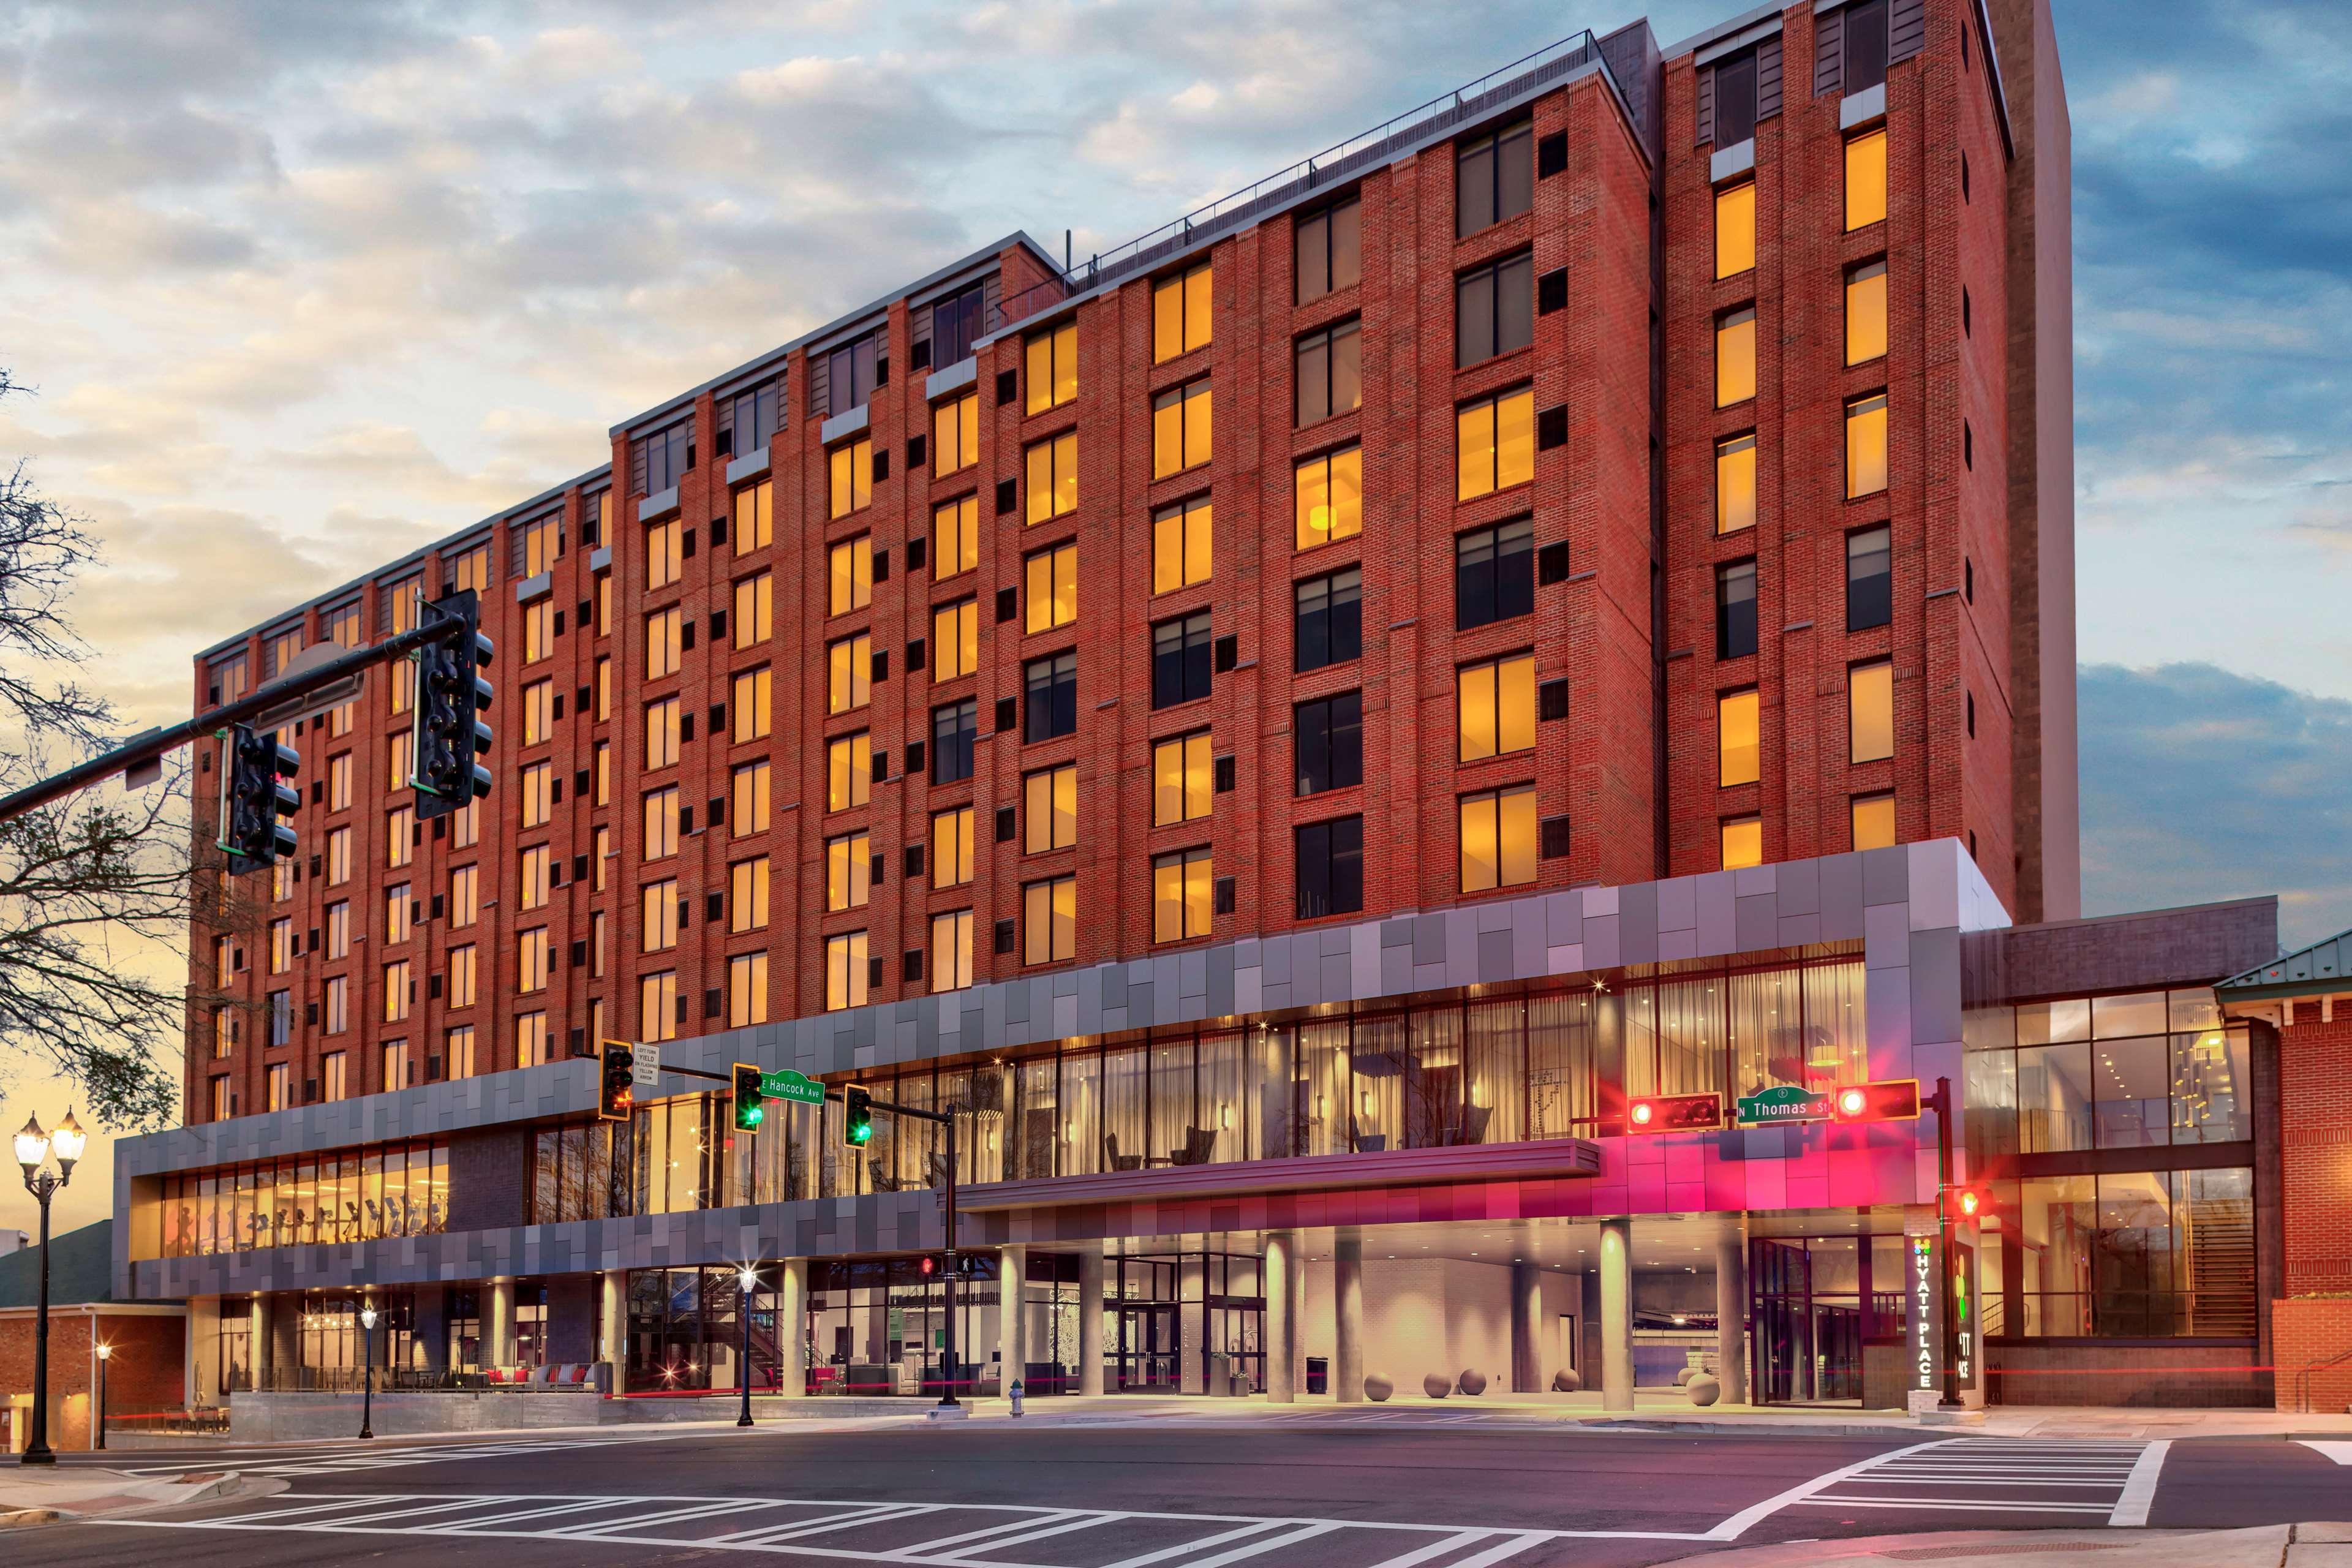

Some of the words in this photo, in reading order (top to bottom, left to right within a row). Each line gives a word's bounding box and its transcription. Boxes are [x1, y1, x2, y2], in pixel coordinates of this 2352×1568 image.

[762, 1080, 767, 1088] E
[770, 1078, 804, 1095] Hancock
[808, 1088, 820, 1098] Ave
[1738, 1107, 1745, 1117] N
[1754, 1102, 1807, 1117] Thomas
[1817, 1102, 1828, 1113] St
[1917, 1255, 1930, 1318] HYATT
[1918, 1323, 1932, 1388] PLACE
